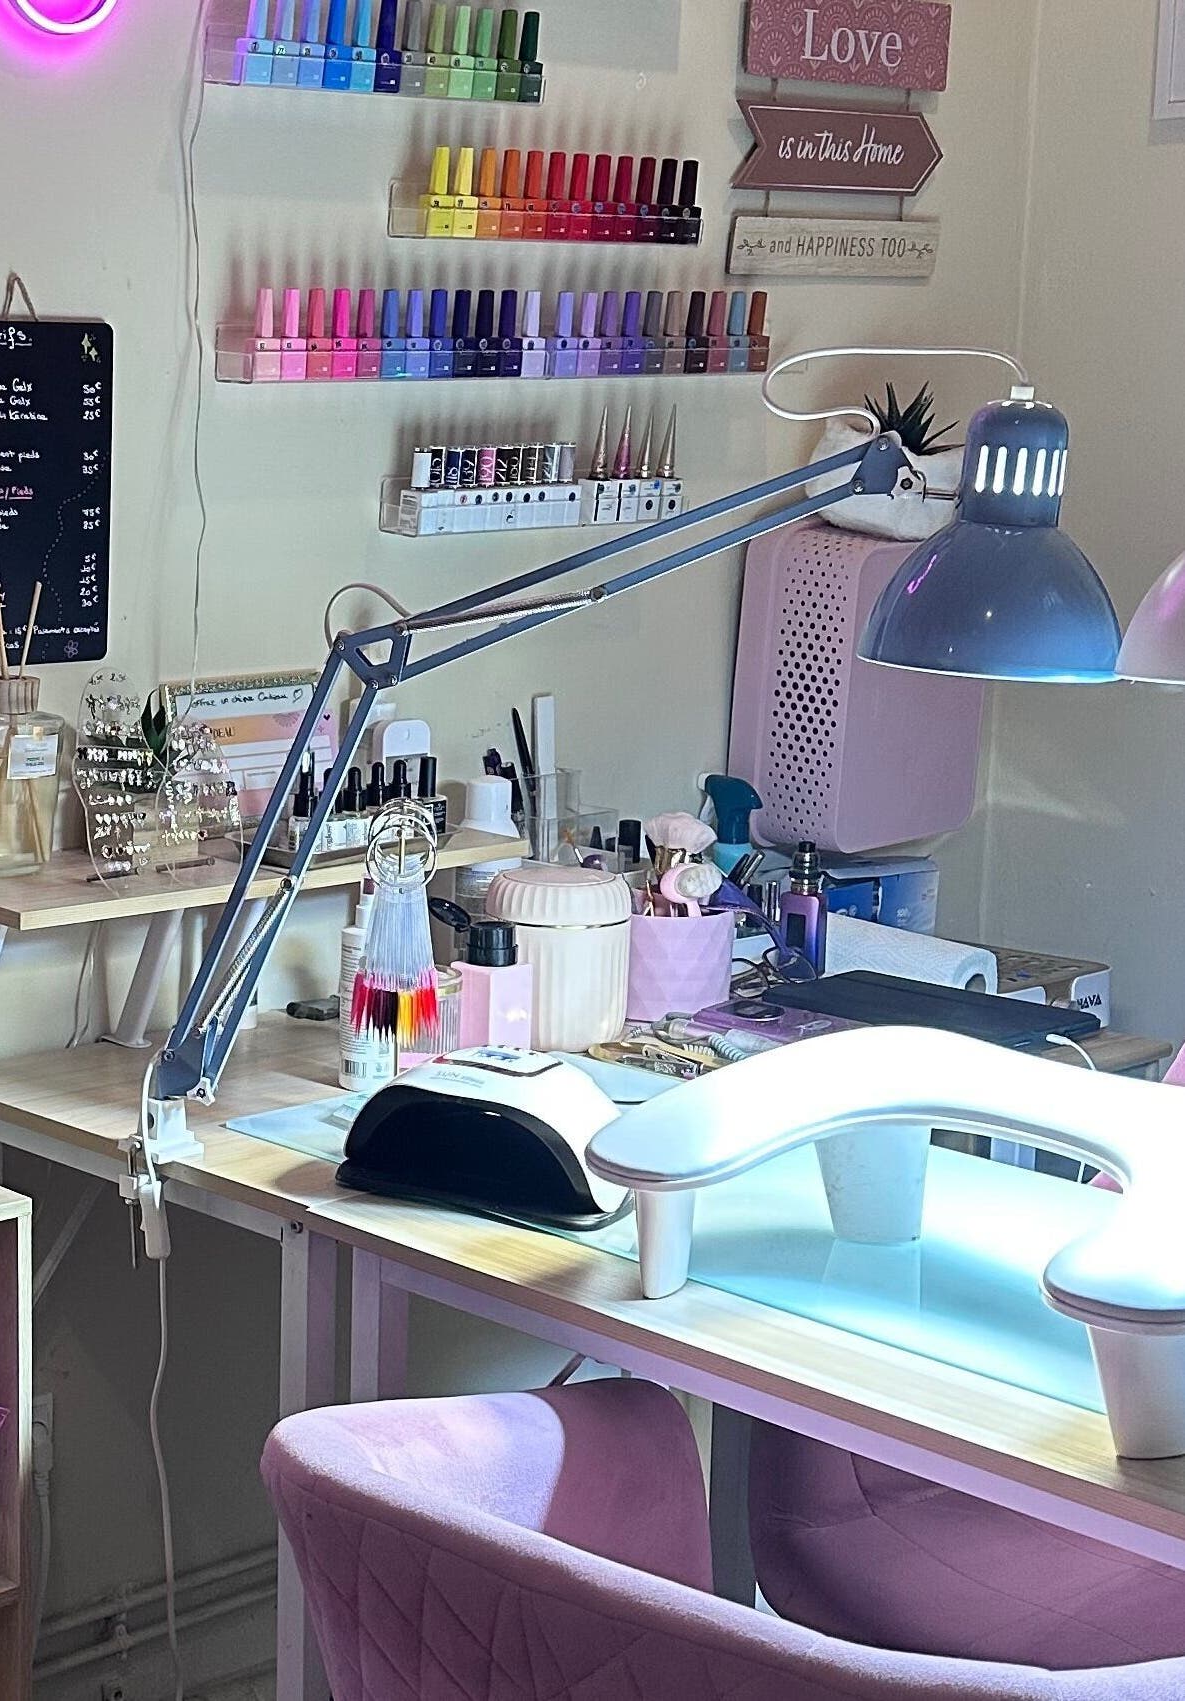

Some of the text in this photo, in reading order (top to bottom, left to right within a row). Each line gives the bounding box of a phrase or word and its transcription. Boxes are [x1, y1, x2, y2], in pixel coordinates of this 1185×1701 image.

[801, 8, 903, 68] Love
[778, 134, 794, 160] is
[796, 135, 818, 160] in
[852, 123, 905, 167] Home
[769, 235, 908, 258] and HAPPINESS TOO
